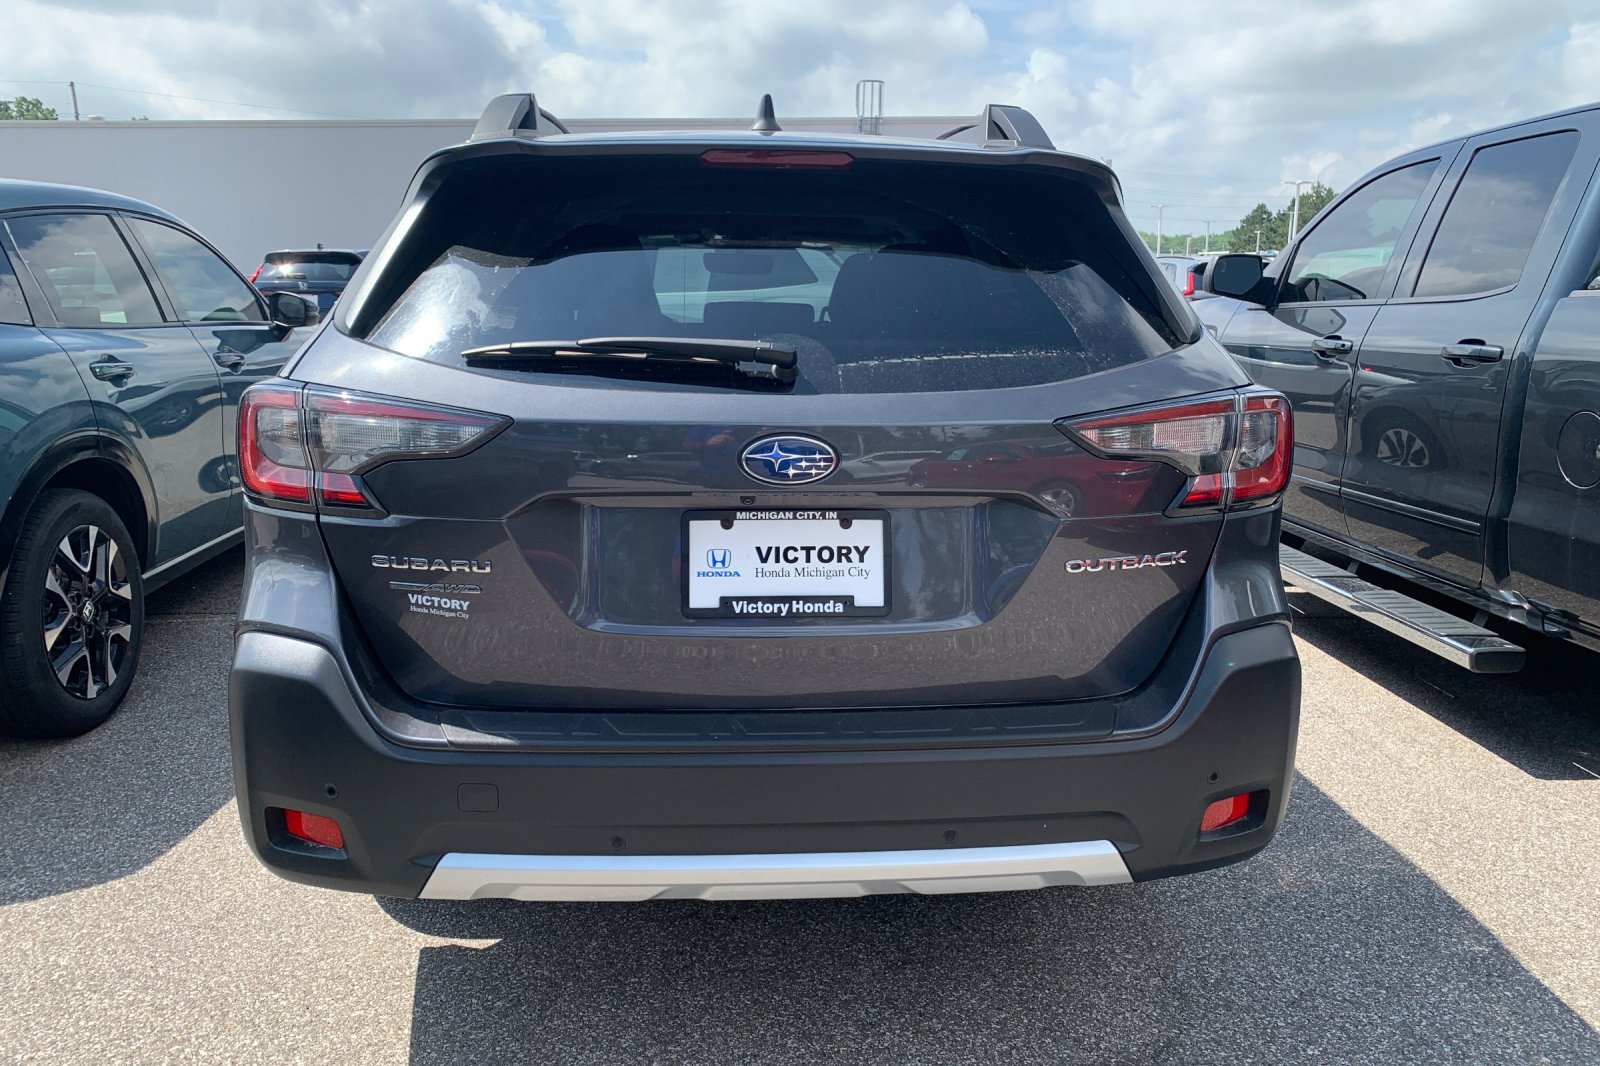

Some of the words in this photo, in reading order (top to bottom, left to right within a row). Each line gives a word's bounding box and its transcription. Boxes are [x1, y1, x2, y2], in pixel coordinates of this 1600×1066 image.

[736, 511, 793, 520] MICHIGAN
[796, 511, 822, 520] CITY,
[825, 511, 837, 520] IN
[371, 554, 492, 573] SUBARU
[755, 546, 870, 564] VICTORY
[1065, 550, 1188, 573] OUTBACK
[755, 567, 790, 578] Honda
[794, 566, 845, 580] Michigan
[848, 566, 870, 579] City
[408, 593, 470, 611] VICTORY
[731, 600, 789, 616] Victory
[792, 600, 844, 613] Honda
[410, 605, 429, 614] Honda
[429, 608, 456, 618] Michigan
[456, 611, 470, 620] City
